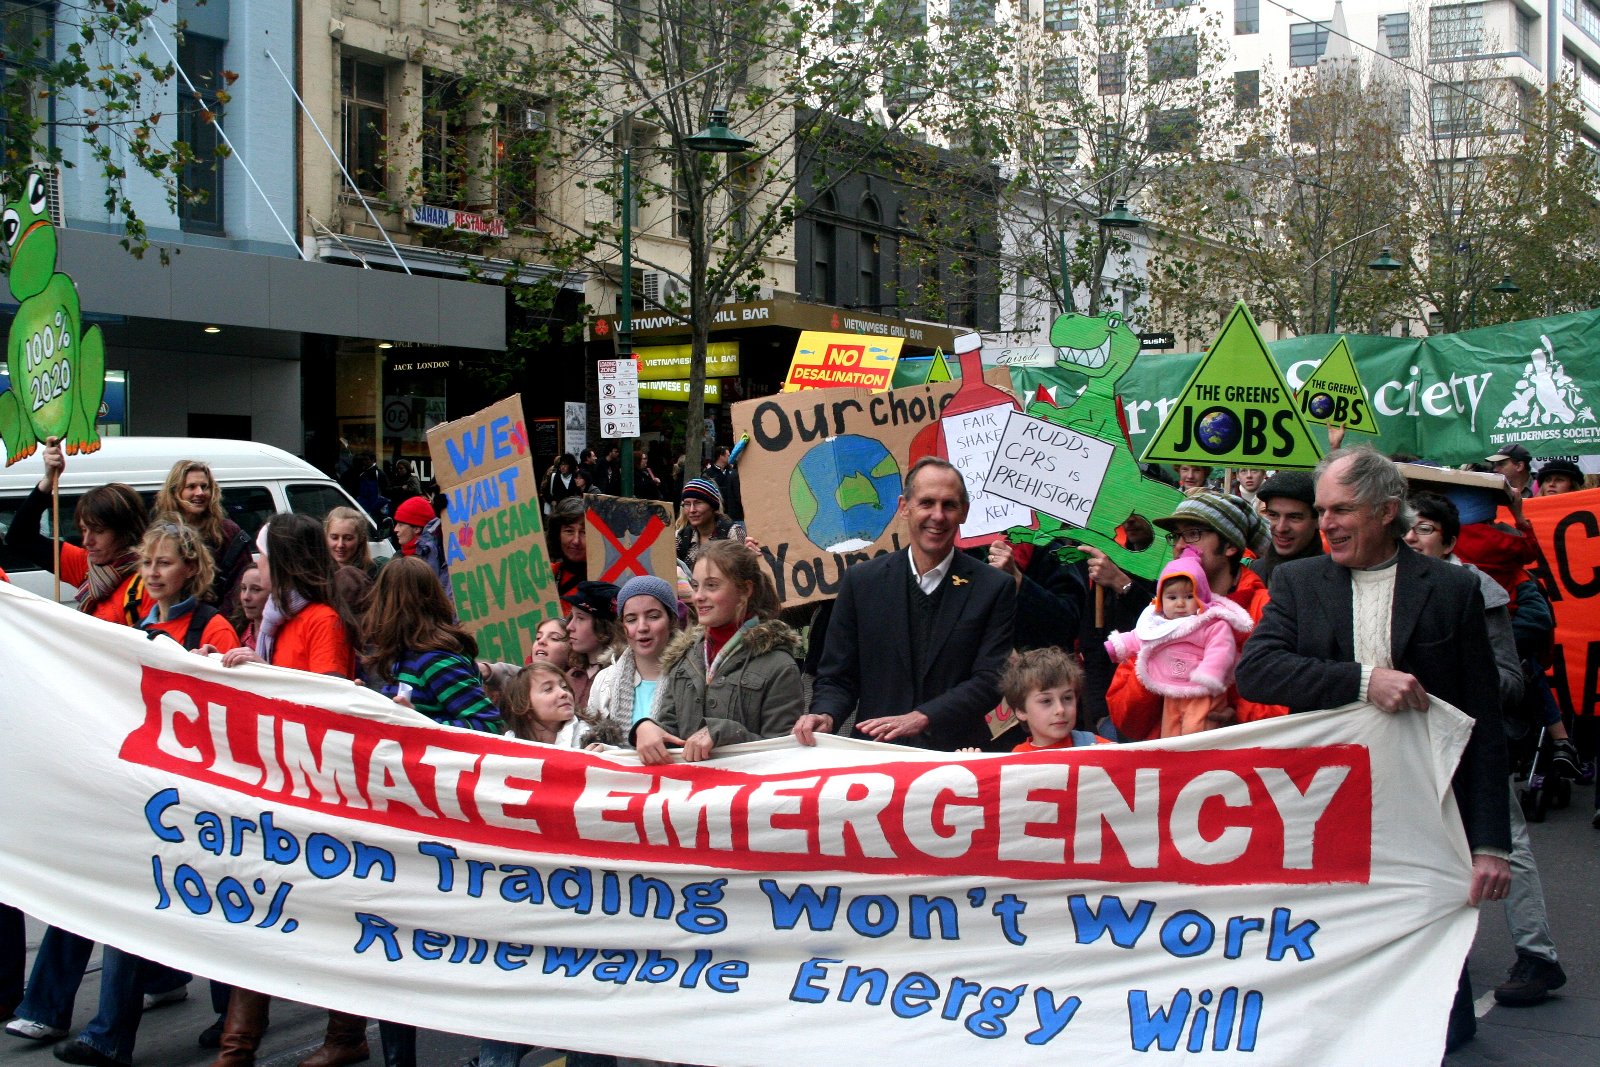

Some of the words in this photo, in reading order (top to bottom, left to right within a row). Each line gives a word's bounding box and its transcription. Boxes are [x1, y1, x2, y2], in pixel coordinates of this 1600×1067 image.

[415, 206, 448, 226] SAHARA
[614, 314, 692, 332] VETNAMES
[743, 308, 768, 320] BAR
[844, 318, 888, 335] VIETNAMESE
[890, 326, 907, 337] GRILL
[909, 330, 923, 340] BAR
[25, 310, 71, 372] 100%
[394, 363, 413, 371] JACK
[417, 361, 450, 370] LONDON
[645, 358, 692, 367] VIETNAMES
[720, 355, 737, 363] BAR
[828, 348, 859, 366] NO
[996, 350, 1040, 365] Episode
[30, 358, 71, 413] 2020
[794, 368, 884, 386] DESALINATION
[1312, 379, 1327, 389] THE
[1327, 382, 1358, 395] GREENS
[704, 385, 718, 394] BAR
[1196, 385, 1220, 401] THE
[1224, 386, 1280, 403] GREENS
[1287, 358, 1492, 432] Sciety
[1301, 390, 1364, 425] JOBS
[752, 399, 863, 452] Our
[869, 386, 958, 426] choic
[962, 412, 997, 431] FAIR
[956, 428, 1002, 449] SHAKE
[1173, 405, 1295, 457] JOBS
[1490, 433, 1504, 444] THE
[1506, 429, 1561, 442] WILDERNESS
[1562, 427, 1600, 438] SOCIETY
[445, 415, 512, 478] WE
[1005, 442, 1058, 472] CPRS
[957, 454, 973, 469] OF
[965, 470, 990, 486] SAU
[992, 465, 1093, 513] PREHISTORIC
[445, 466, 520, 525] WANT
[985, 503, 1016, 523] KEV!
[446, 531, 467, 566] A
[475, 496, 541, 551] CLEAN
[156, 690, 546, 834] CLIMATE
[573, 764, 1352, 870] EMERGENCY
[145, 787, 396, 883] Carbon
[418, 841, 729, 934] Trading
[759, 878, 1027, 946] Won't
[1067, 894, 1320, 962] Work
[151, 854, 300, 934] 100%
[353, 911, 749, 994] Renewable
[789, 956, 1082, 1046] Energy
[1127, 986, 1263, 1053] Will
